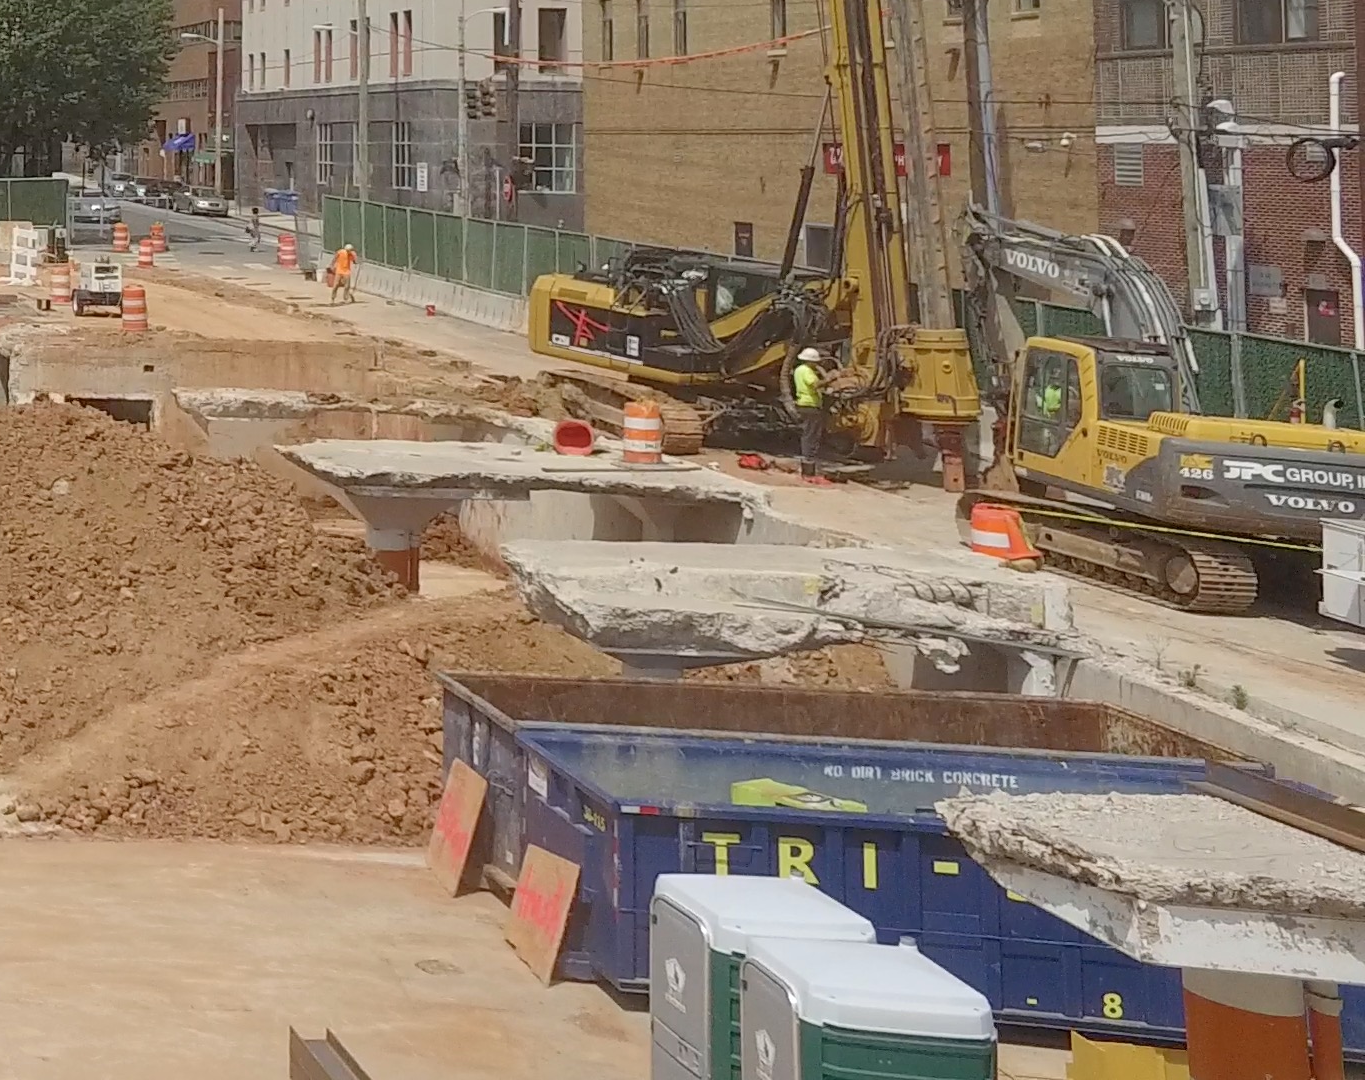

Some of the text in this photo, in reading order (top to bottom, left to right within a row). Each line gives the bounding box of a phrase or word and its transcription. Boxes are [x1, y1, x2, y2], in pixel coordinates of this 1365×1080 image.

[1005, 248, 1060, 278] VOLVO
[1116, 355, 1154, 364] VOLVO
[1096, 448, 1128, 464] VOLVO
[1179, 467, 1215, 481] 426
[1222, 459, 1286, 483] JPC
[1286, 467, 1355, 490] GROUP,
[1264, 493, 1356, 514] VOLVO
[851, 765, 882, 780] DIRT
[890, 768, 935, 784] BRICK
[942, 771, 1020, 789] CONCRETE
